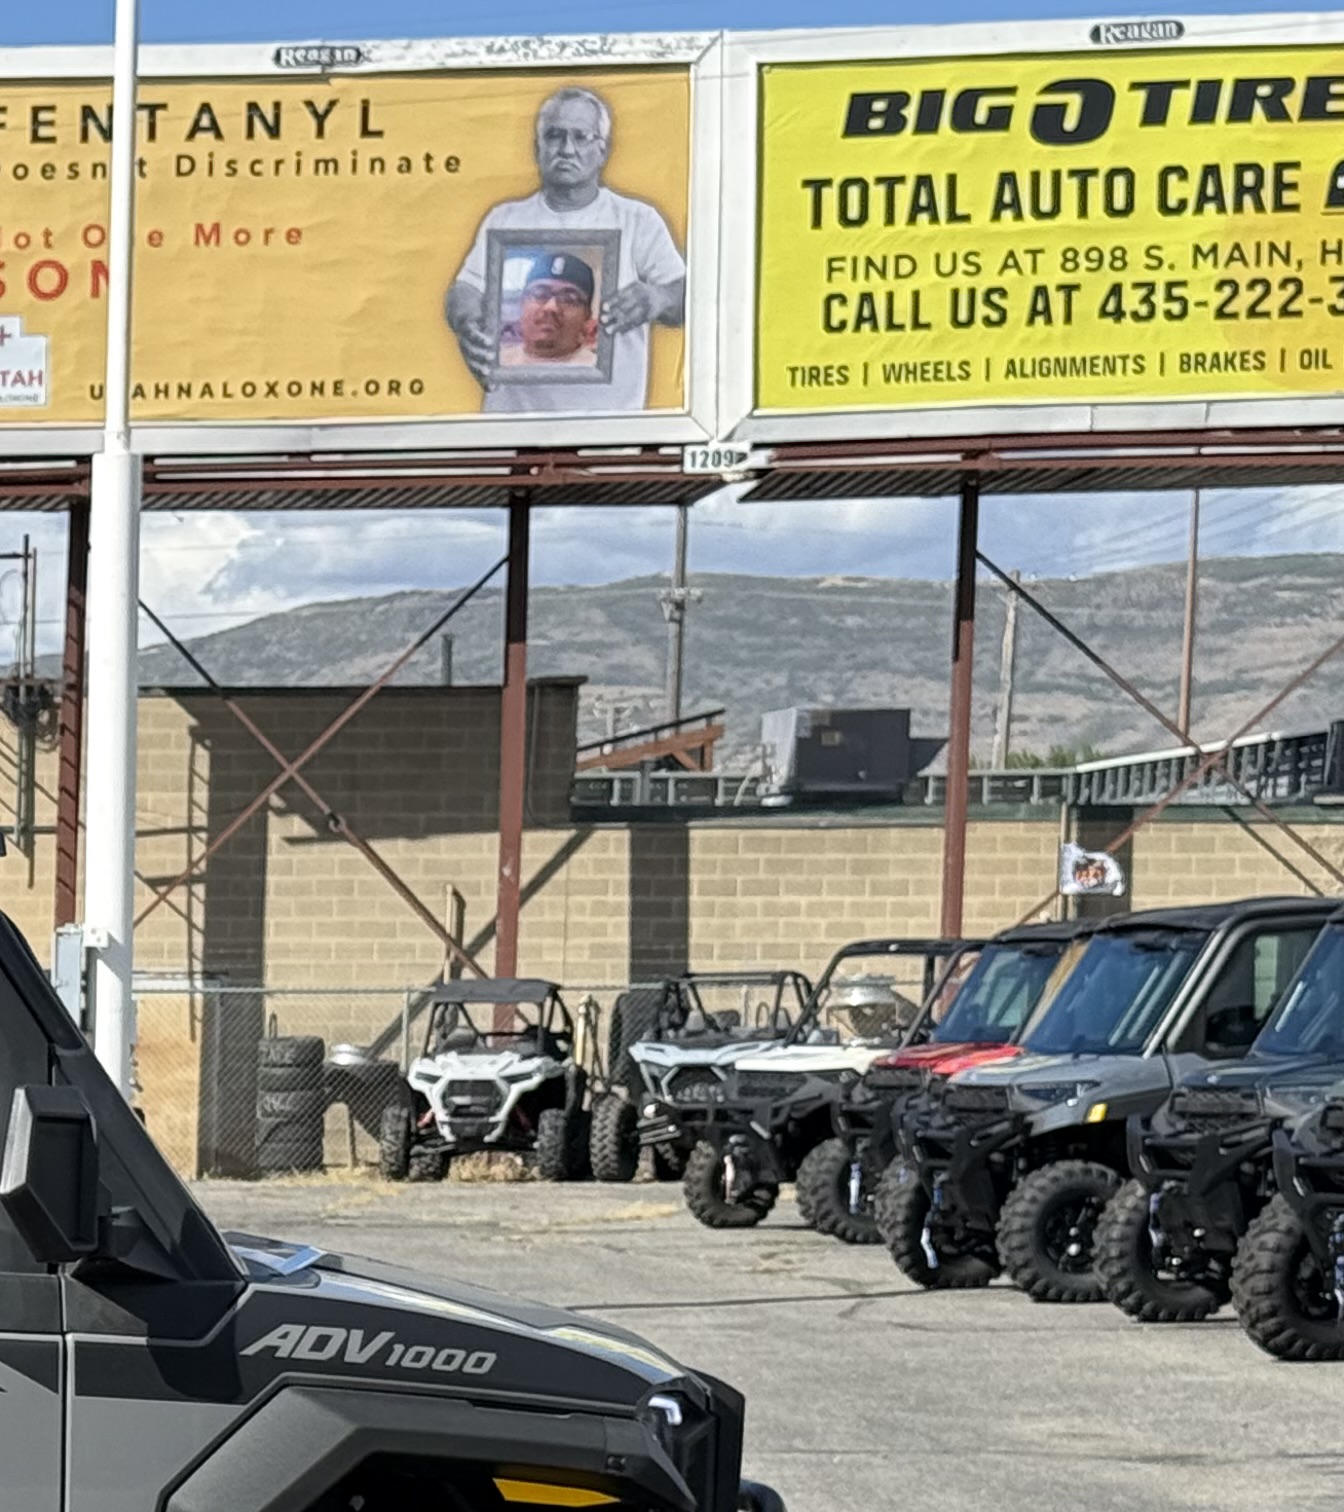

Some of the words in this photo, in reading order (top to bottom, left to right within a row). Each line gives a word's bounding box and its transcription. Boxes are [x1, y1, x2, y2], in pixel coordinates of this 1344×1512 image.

[841, 85, 1018, 139] BIG
[1030, 77, 1116, 146] O
[175, 149, 461, 178] Discriminate
[802, 172, 971, 230] TOTAL
[990, 166, 1137, 222] AUTO
[1157, 160, 1302, 217] CARE
[82, 223, 164, 249] Oe
[193, 222, 304, 248] More
[826, 254, 918, 283] FIND
[934, 250, 982, 278] US
[997, 248, 1045, 276] AT
[1060, 245, 1128, 273] 898
[1143, 245, 1176, 271] S.
[1191, 239, 1304, 272] MAIN,
[823, 288, 932, 334] CALL
[949, 286, 1009, 330] US
[1025, 284, 1080, 327] AT
[787, 364, 850, 388] TIRES
[882, 359, 972, 385] WHEELS
[1003, 354, 1146, 379] ALIGNMENTS
[1179, 350, 1266, 375] BRAKES
[1299, 347, 1333, 371] OIL
[88, 378, 425, 401] UAHNALOXONE.ORG
